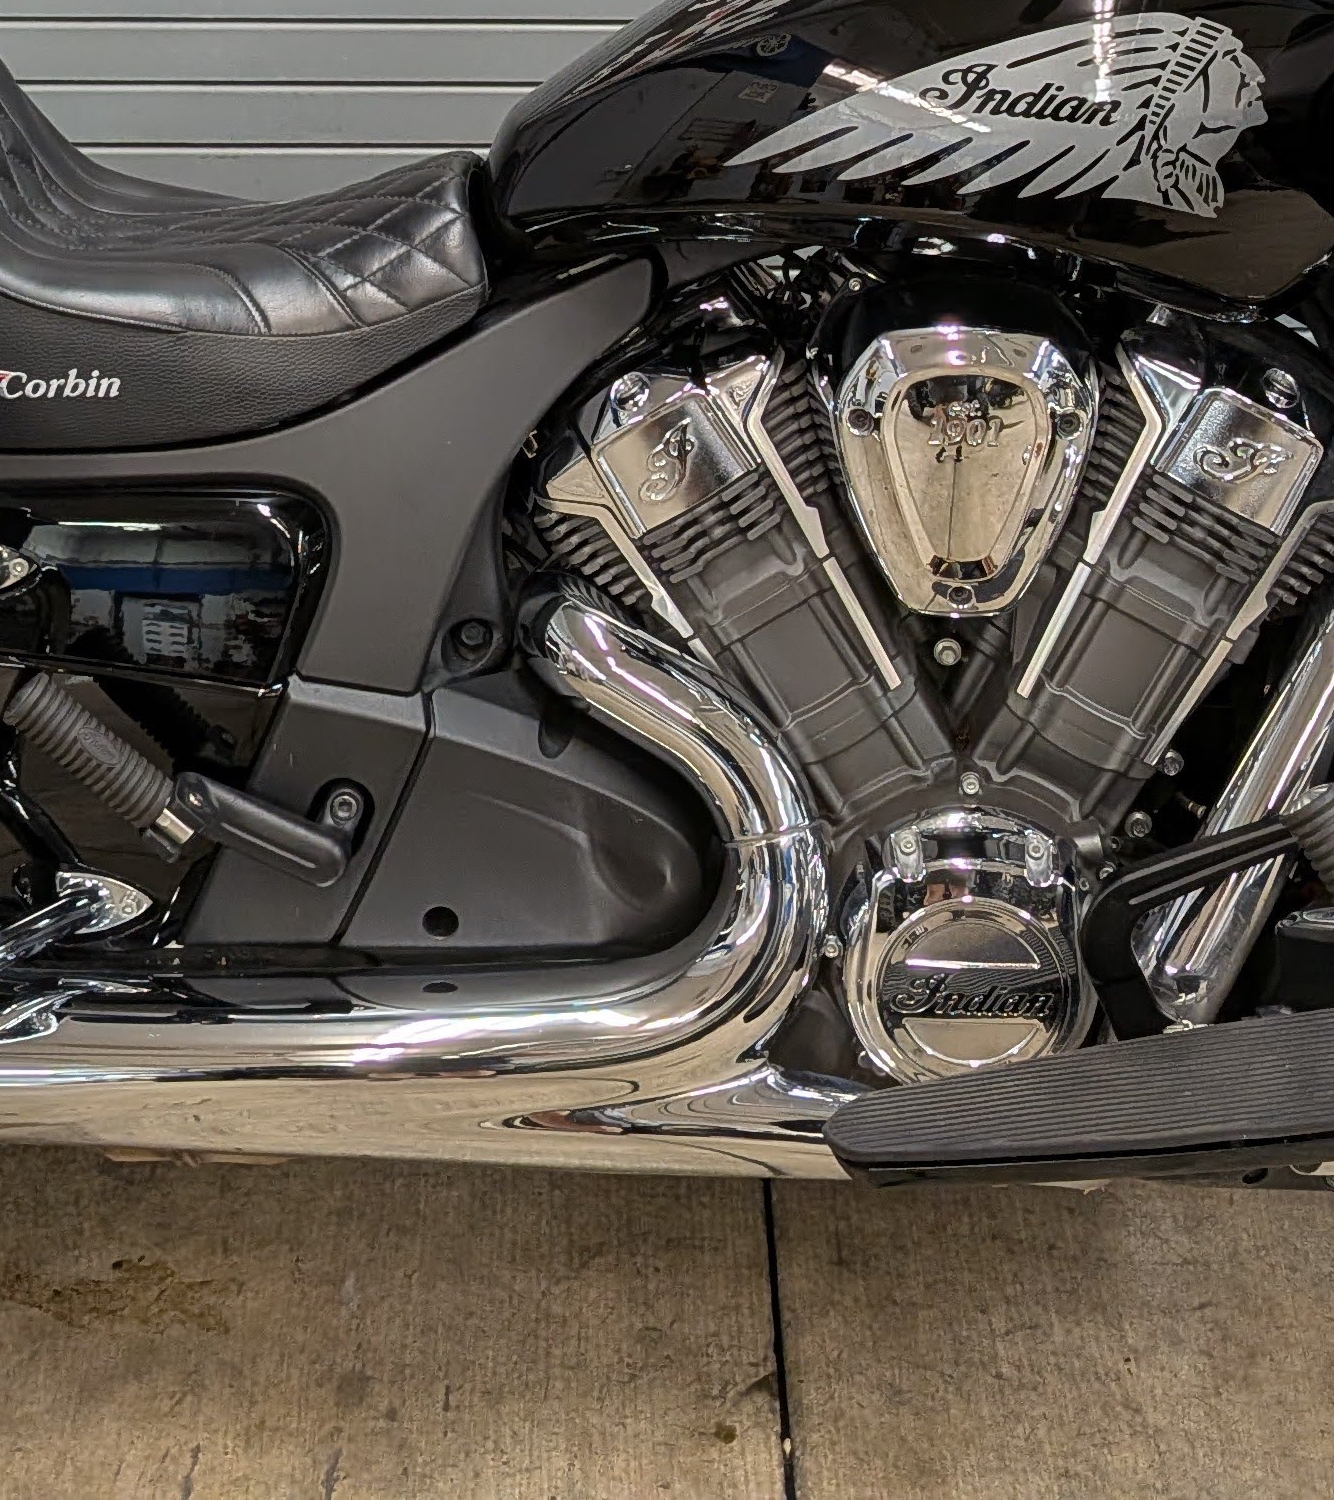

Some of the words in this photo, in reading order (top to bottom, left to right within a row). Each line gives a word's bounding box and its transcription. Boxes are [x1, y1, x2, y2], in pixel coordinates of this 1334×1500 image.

[918, 62, 1123, 128] Indian
[0, 367, 122, 400] Corbin
[927, 417, 1001, 447] 1901
[889, 972, 1055, 1018] Indian
